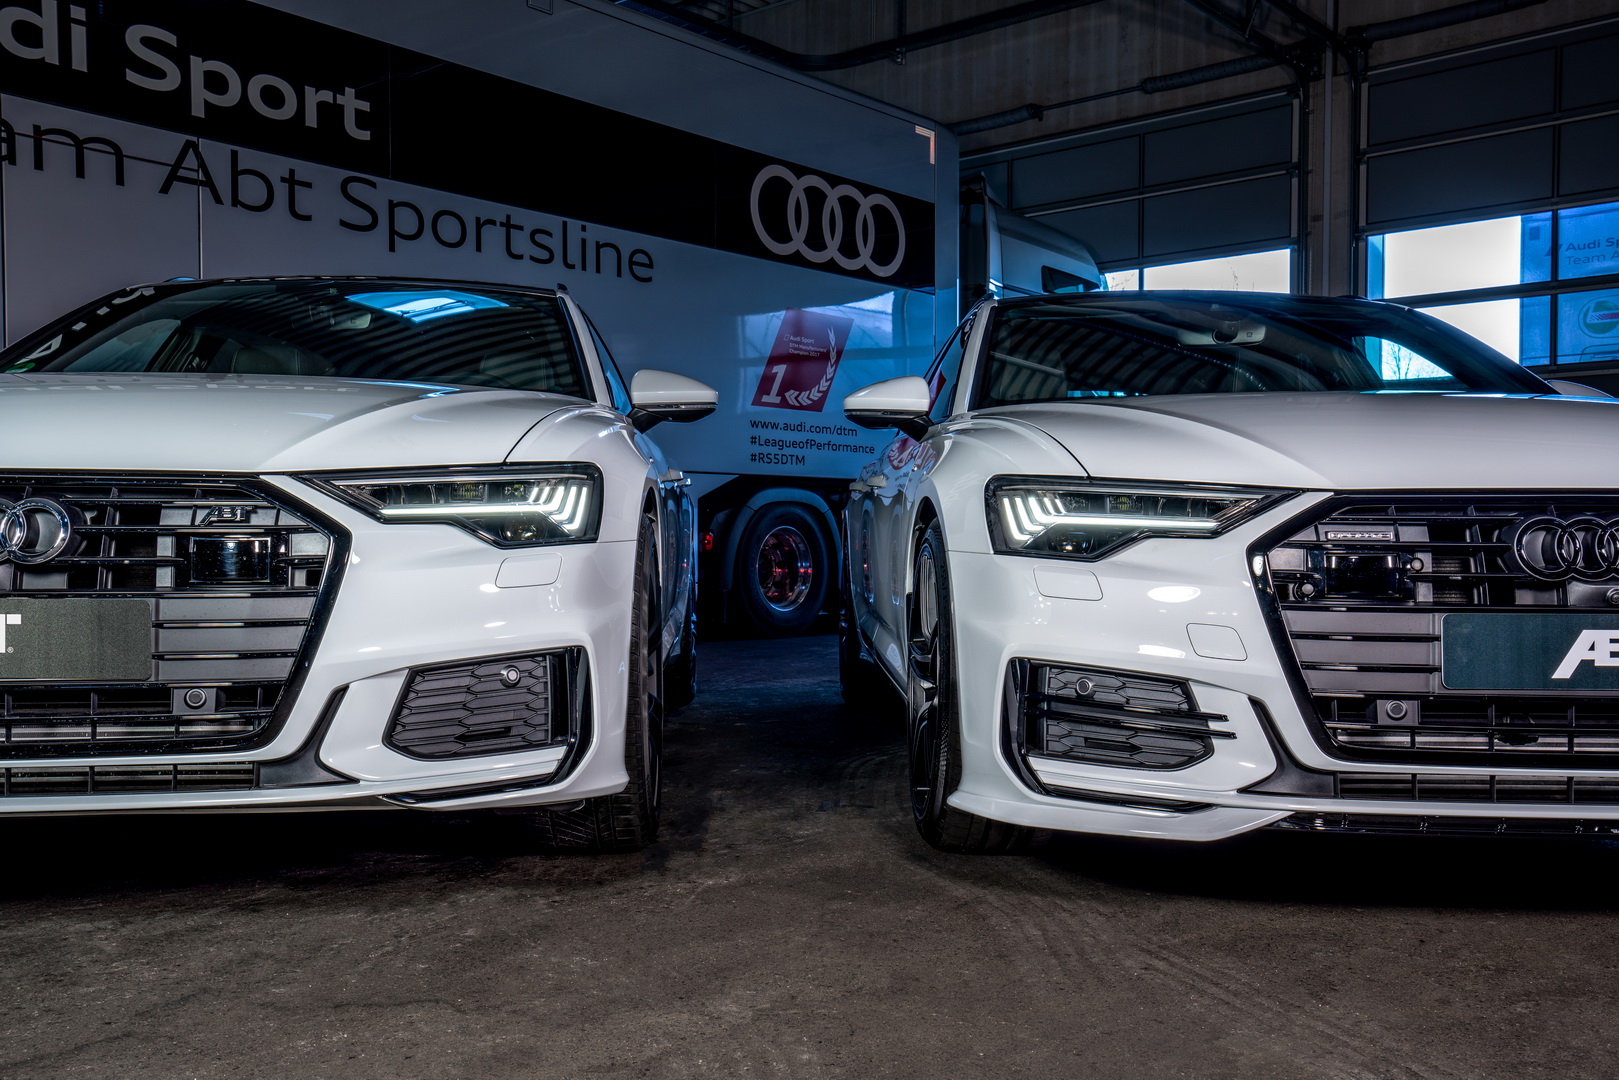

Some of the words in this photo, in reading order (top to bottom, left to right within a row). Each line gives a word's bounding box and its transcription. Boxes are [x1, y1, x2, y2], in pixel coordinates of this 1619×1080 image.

[124, 23, 371, 141] Sport
[158, 138, 313, 222] Abt
[338, 176, 655, 284] Sportsline
[1565, 239, 1601, 252] Audi
[1565, 254, 1606, 265] Team
[801, 336, 815, 344] Sport
[761, 364, 787, 404] 1
[750, 419, 858, 437] www.audi.com/dtm
[750, 436, 875, 454] #LeagueofPerformance
[750, 453, 805, 466] #RS5DTM
[198, 505, 253, 526] ABT
